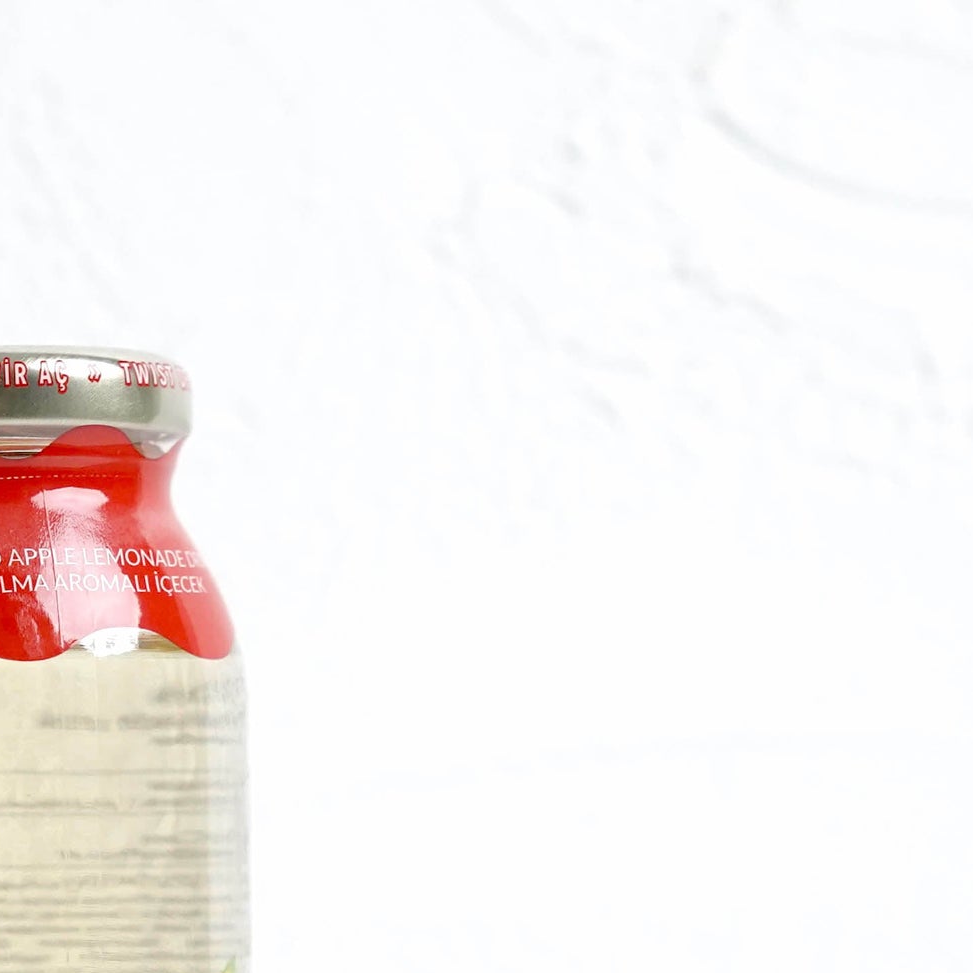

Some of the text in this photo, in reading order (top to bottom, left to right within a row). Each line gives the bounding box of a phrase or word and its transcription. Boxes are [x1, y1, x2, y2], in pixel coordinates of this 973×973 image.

[38, 361, 69, 393] AÇ
[118, 360, 174, 388] TWIST
[8, 548, 75, 570] APPLE
[84, 548, 185, 568] LEMONADE
[53, 573, 151, 593] AROMALI
[154, 571, 207, 597] İÇECEK
